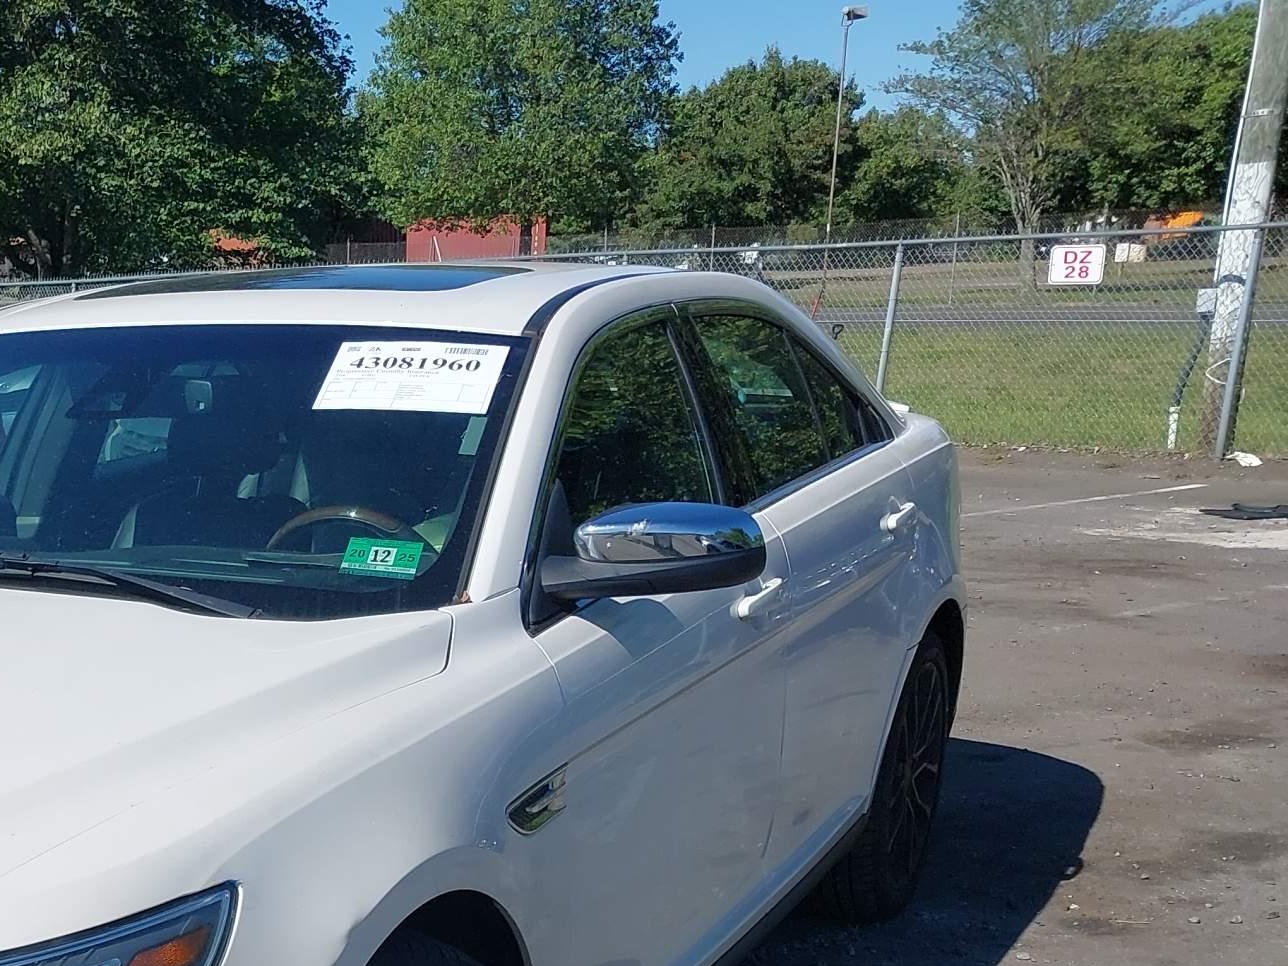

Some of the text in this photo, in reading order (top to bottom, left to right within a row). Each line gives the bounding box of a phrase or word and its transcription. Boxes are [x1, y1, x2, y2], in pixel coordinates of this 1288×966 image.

[1064, 250, 1093, 264] DZ
[1064, 265, 1089, 279] 28
[349, 356, 481, 372] 43081960
[349, 548, 417, 563] 20 12 25
